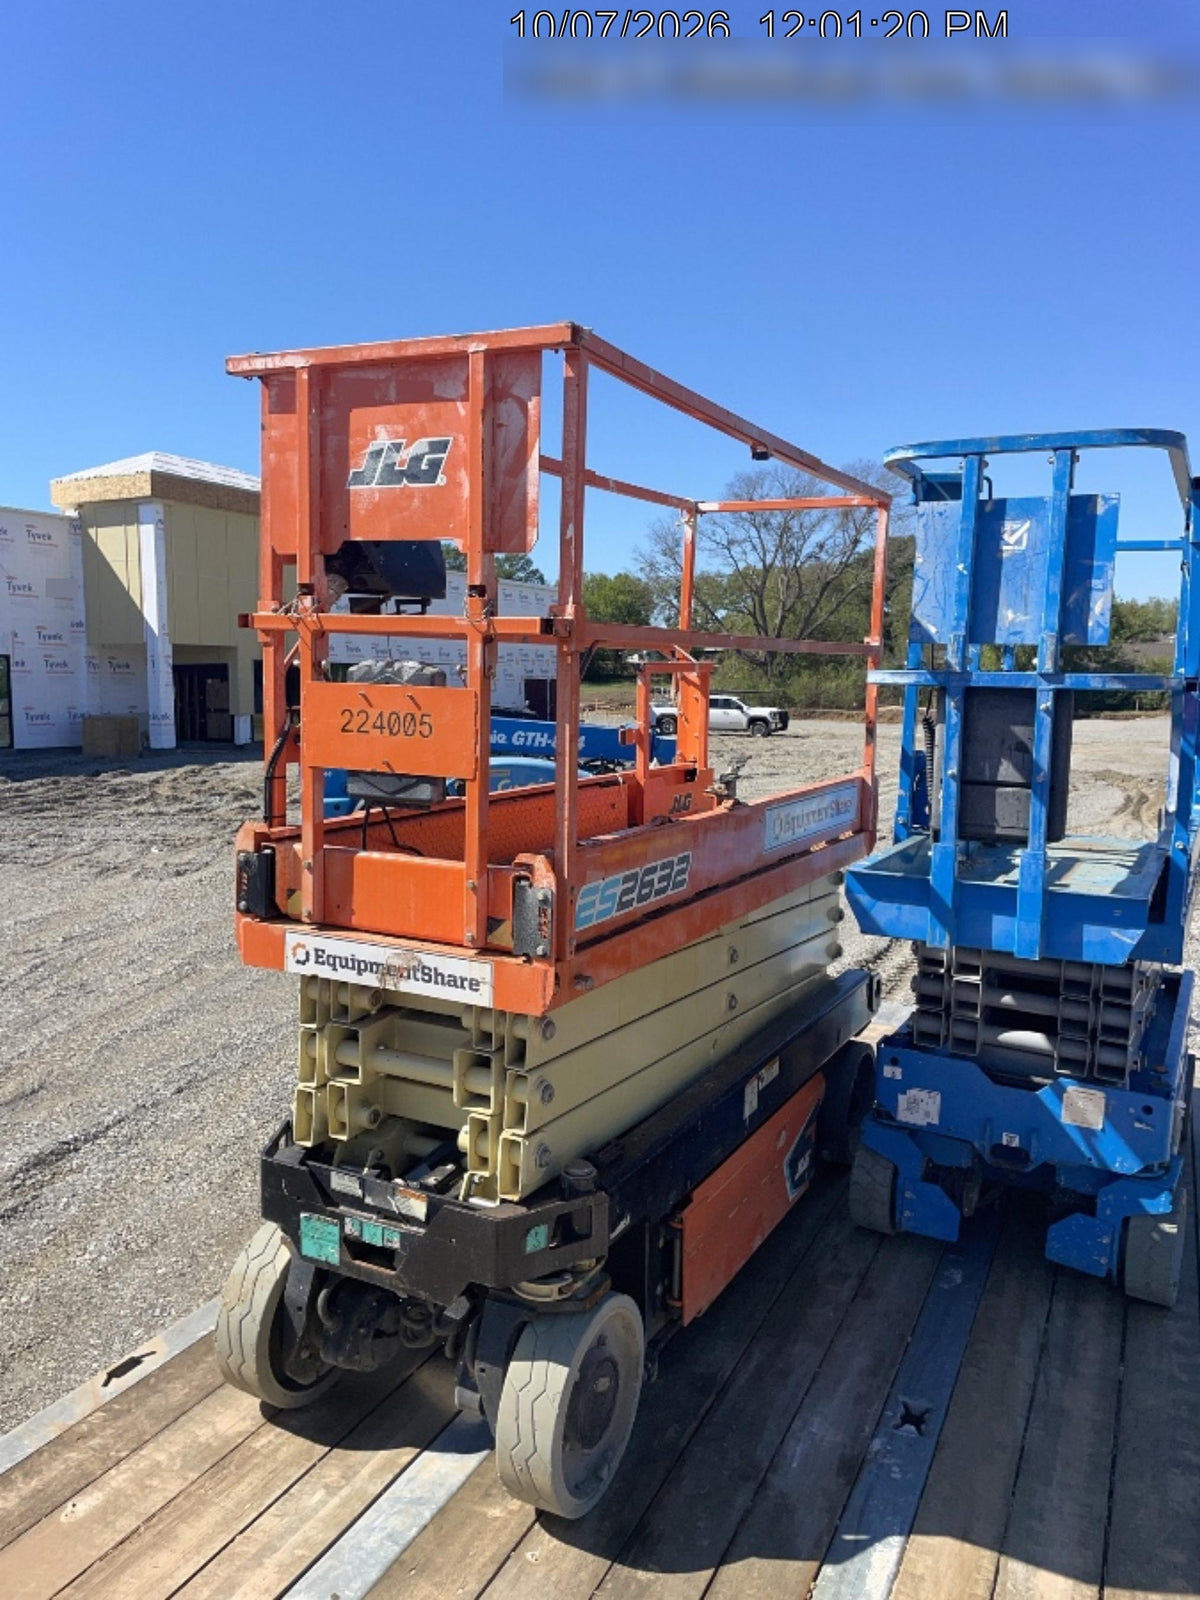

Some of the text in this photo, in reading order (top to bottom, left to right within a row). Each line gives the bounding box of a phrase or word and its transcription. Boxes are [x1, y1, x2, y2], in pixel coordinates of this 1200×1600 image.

[346, 436, 454, 489] JLG
[340, 708, 433, 739] 224005
[574, 851, 692, 932] ES2632
[313, 947, 481, 993] EquipmentShare
